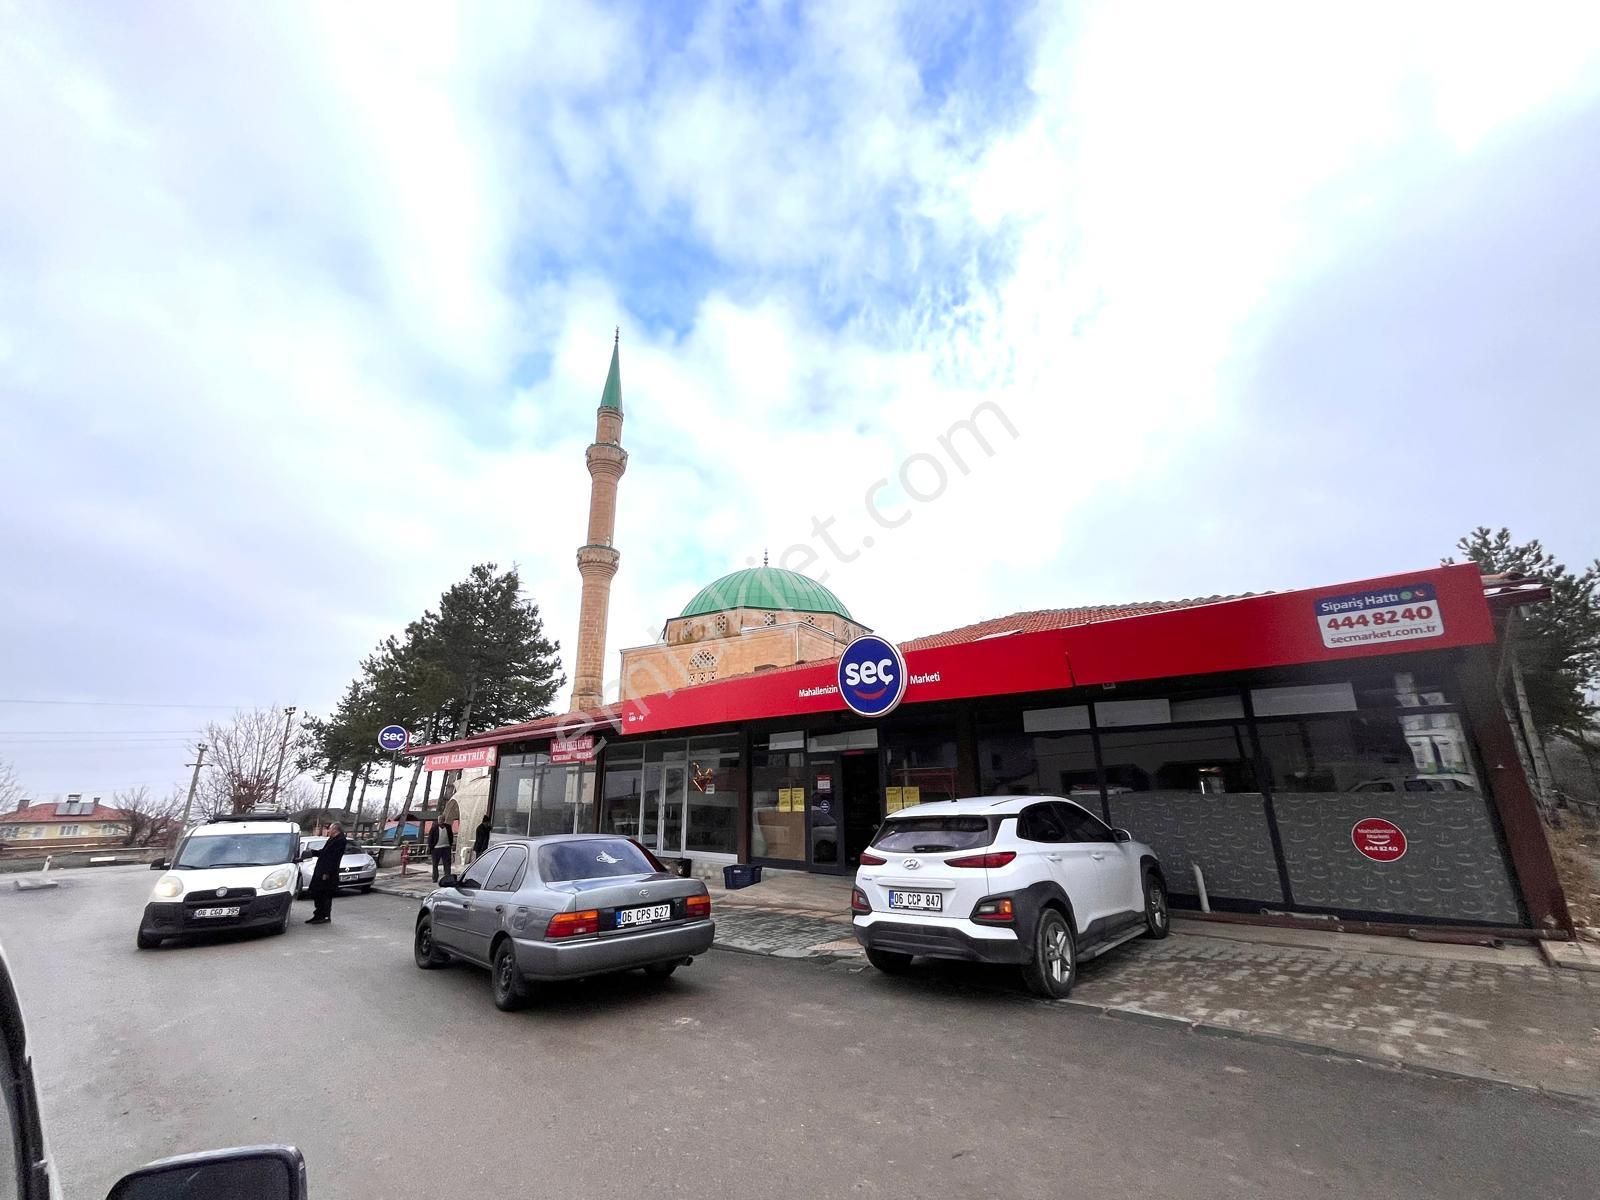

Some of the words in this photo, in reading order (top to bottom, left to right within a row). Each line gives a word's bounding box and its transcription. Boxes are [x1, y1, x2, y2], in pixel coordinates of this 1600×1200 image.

[1321, 597, 1364, 612] Sipariş
[1365, 593, 1399, 606] Hattı
[1330, 624, 1436, 643] secmarket.com.tr
[799, 685, 838, 697] Mahallenizin
[845, 658, 894, 686] seç
[910, 671, 940, 685] Marketi
[894, 892, 904, 905] 06
[907, 893, 922, 906] CCP
[925, 894, 940, 907] 847
[622, 911, 632, 923] 06
[636, 908, 651, 921] CPS
[654, 905, 669, 918] 627
